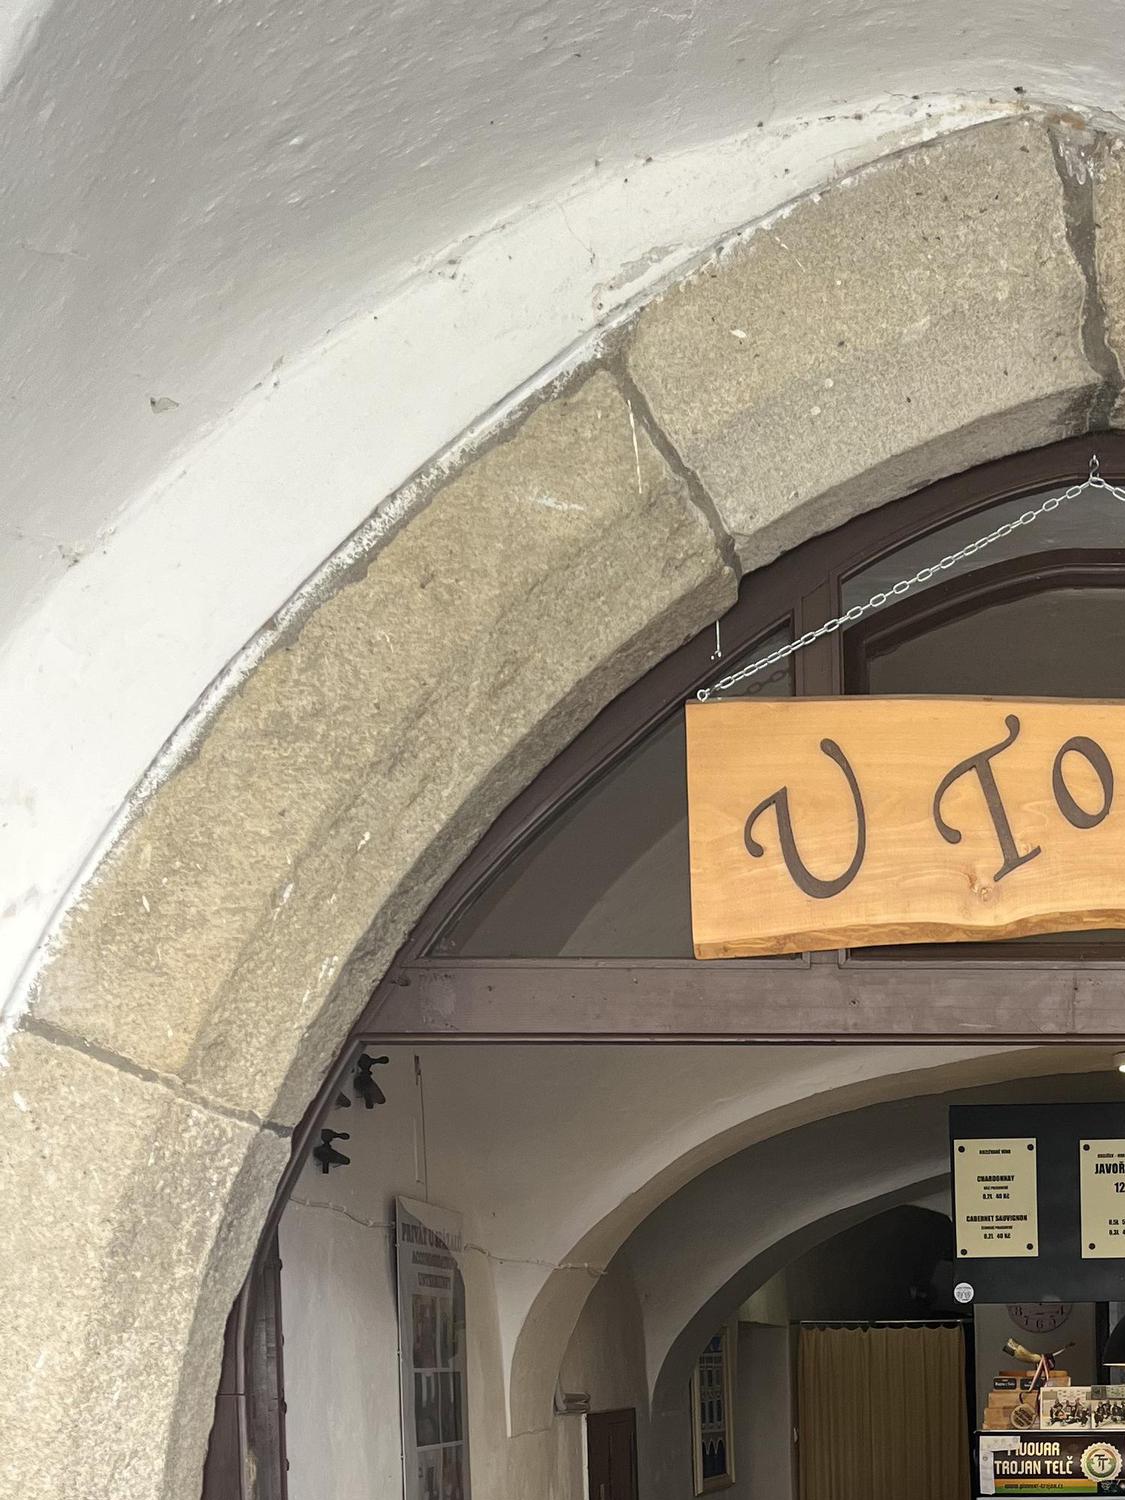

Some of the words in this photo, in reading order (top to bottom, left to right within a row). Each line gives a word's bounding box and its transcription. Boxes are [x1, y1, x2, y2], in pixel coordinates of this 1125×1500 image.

[744, 738, 866, 899] U
[1036, 1320, 1044, 1328] 6
[994, 1460, 1041, 1474] TROJAN
[1044, 1456, 1074, 1474] TELČ
